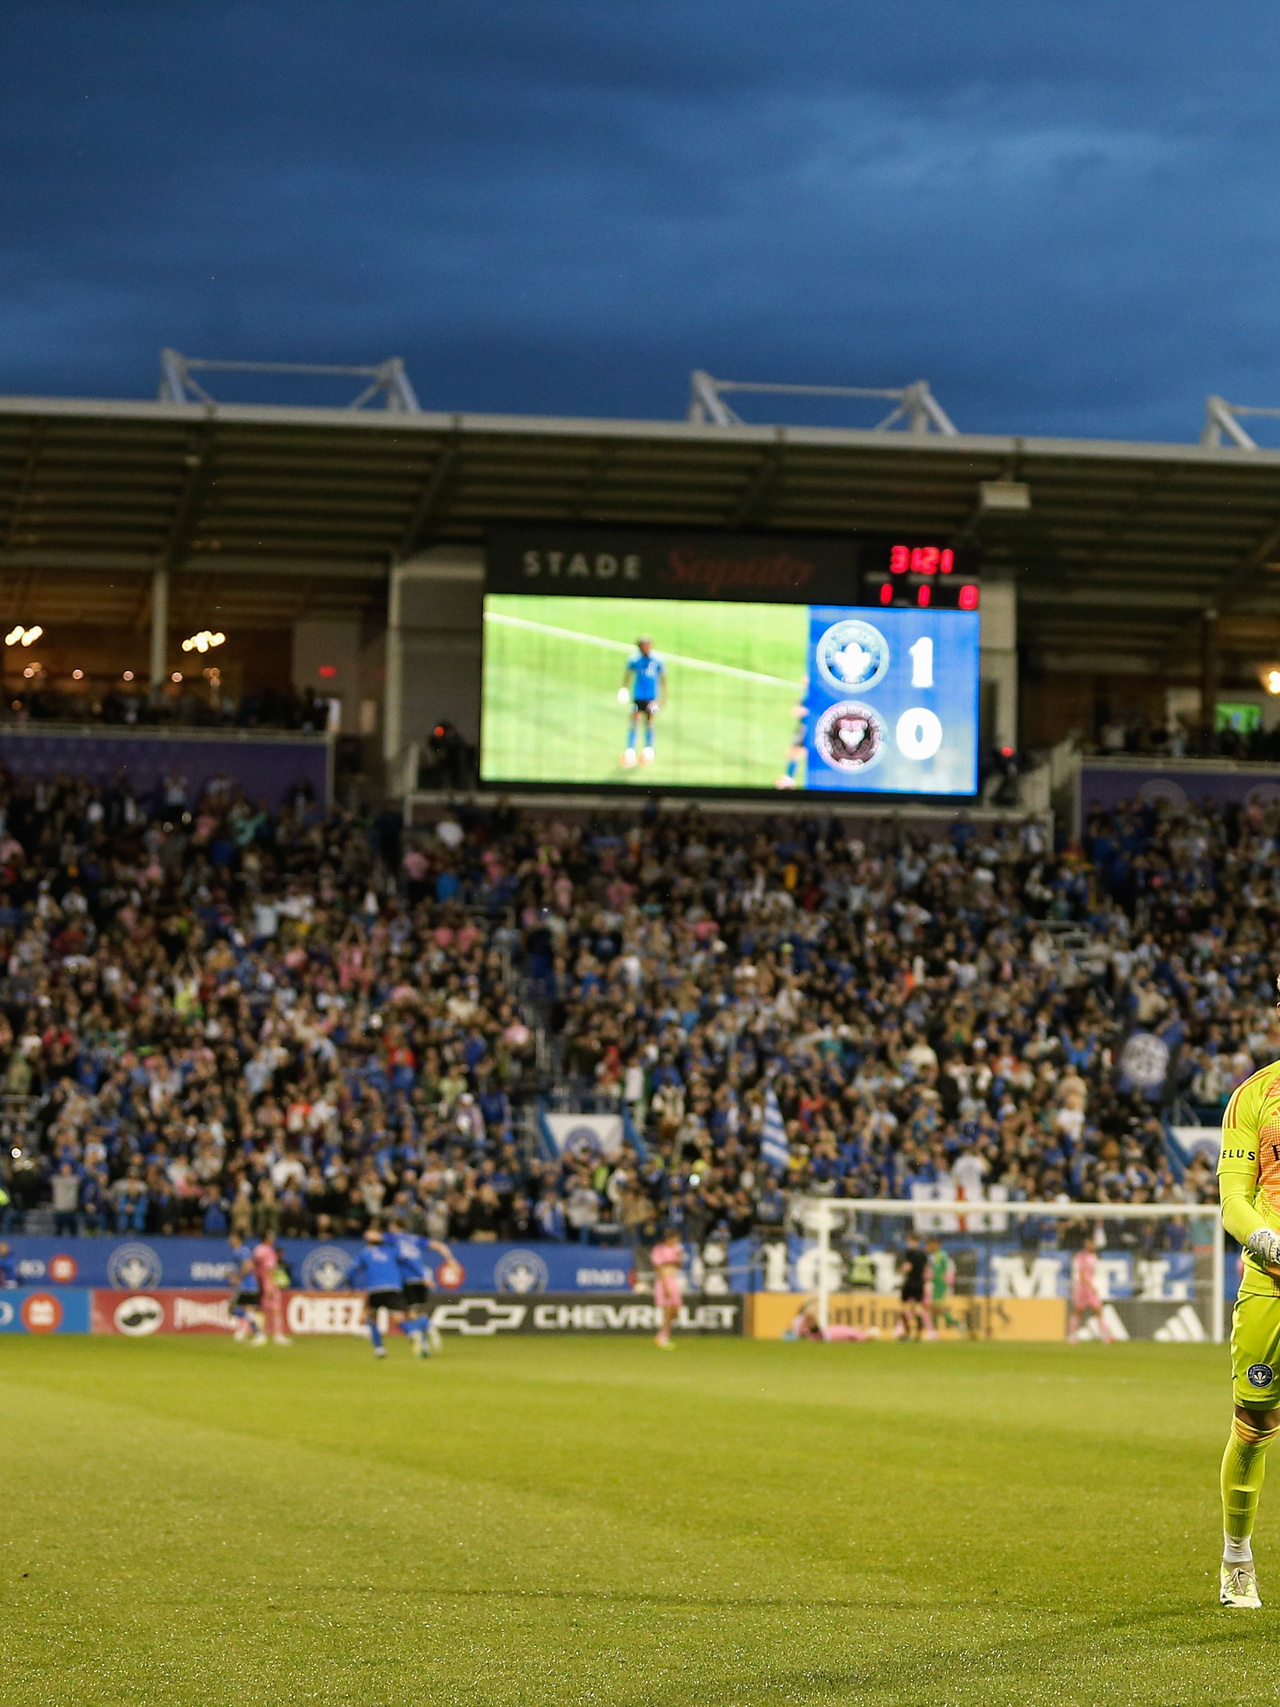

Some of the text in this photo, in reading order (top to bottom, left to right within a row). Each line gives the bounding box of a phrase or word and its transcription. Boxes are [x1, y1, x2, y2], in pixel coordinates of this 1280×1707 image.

[522, 550, 641, 580] STADE
[909, 636, 934, 688] 1
[896, 707, 943, 761] 0
[1221, 1149, 1256, 1161] ELUS
